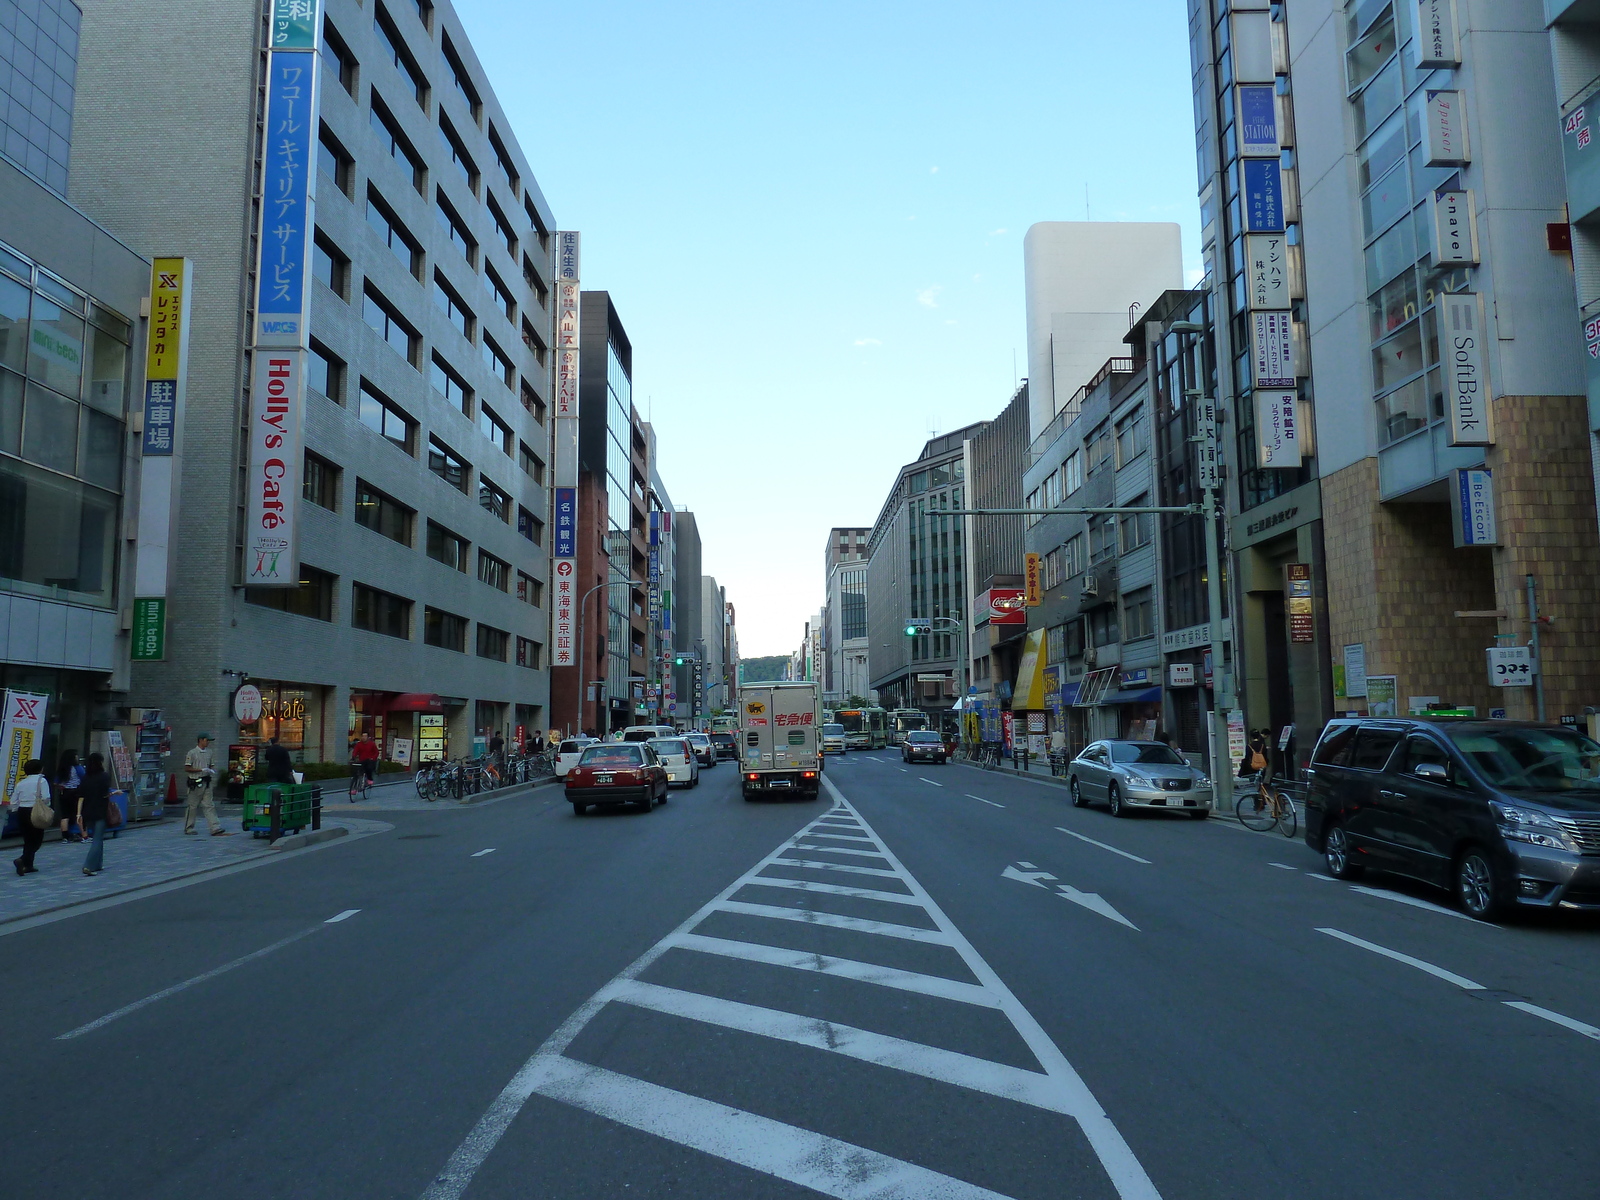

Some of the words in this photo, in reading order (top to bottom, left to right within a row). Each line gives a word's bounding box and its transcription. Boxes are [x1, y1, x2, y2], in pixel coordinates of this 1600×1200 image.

[289, 0, 313, 20] 科
[1244, 125, 1274, 139] STATION
[272, 67, 302, 301] ワコールキャリアサービス
[1263, 163, 1275, 227] アシハラ株式会社
[563, 232, 575, 279] 住友生命
[1268, 239, 1282, 290] アシハラ
[1255, 260, 1267, 305] 株式会社
[155, 296, 167, 367] レンタカー
[262, 321, 298, 333] WACS
[563, 309, 574, 345] ヘルス
[261, 360, 291, 449] Holly's
[1454, 337, 1479, 431] SoftBank
[149, 381, 172, 449] 駐車場
[1271, 403, 1281, 451] リラクゼーション
[1265, 444, 1273, 463] サロン
[262, 458, 286, 529] Café
[559, 502, 570, 554] 名鉄観光
[1028, 557, 1037, 602] キンキホーム
[145, 627, 158, 656] tech
[557, 581, 570, 663] 東海東京証券
[774, 712, 813, 726] 宅急便
